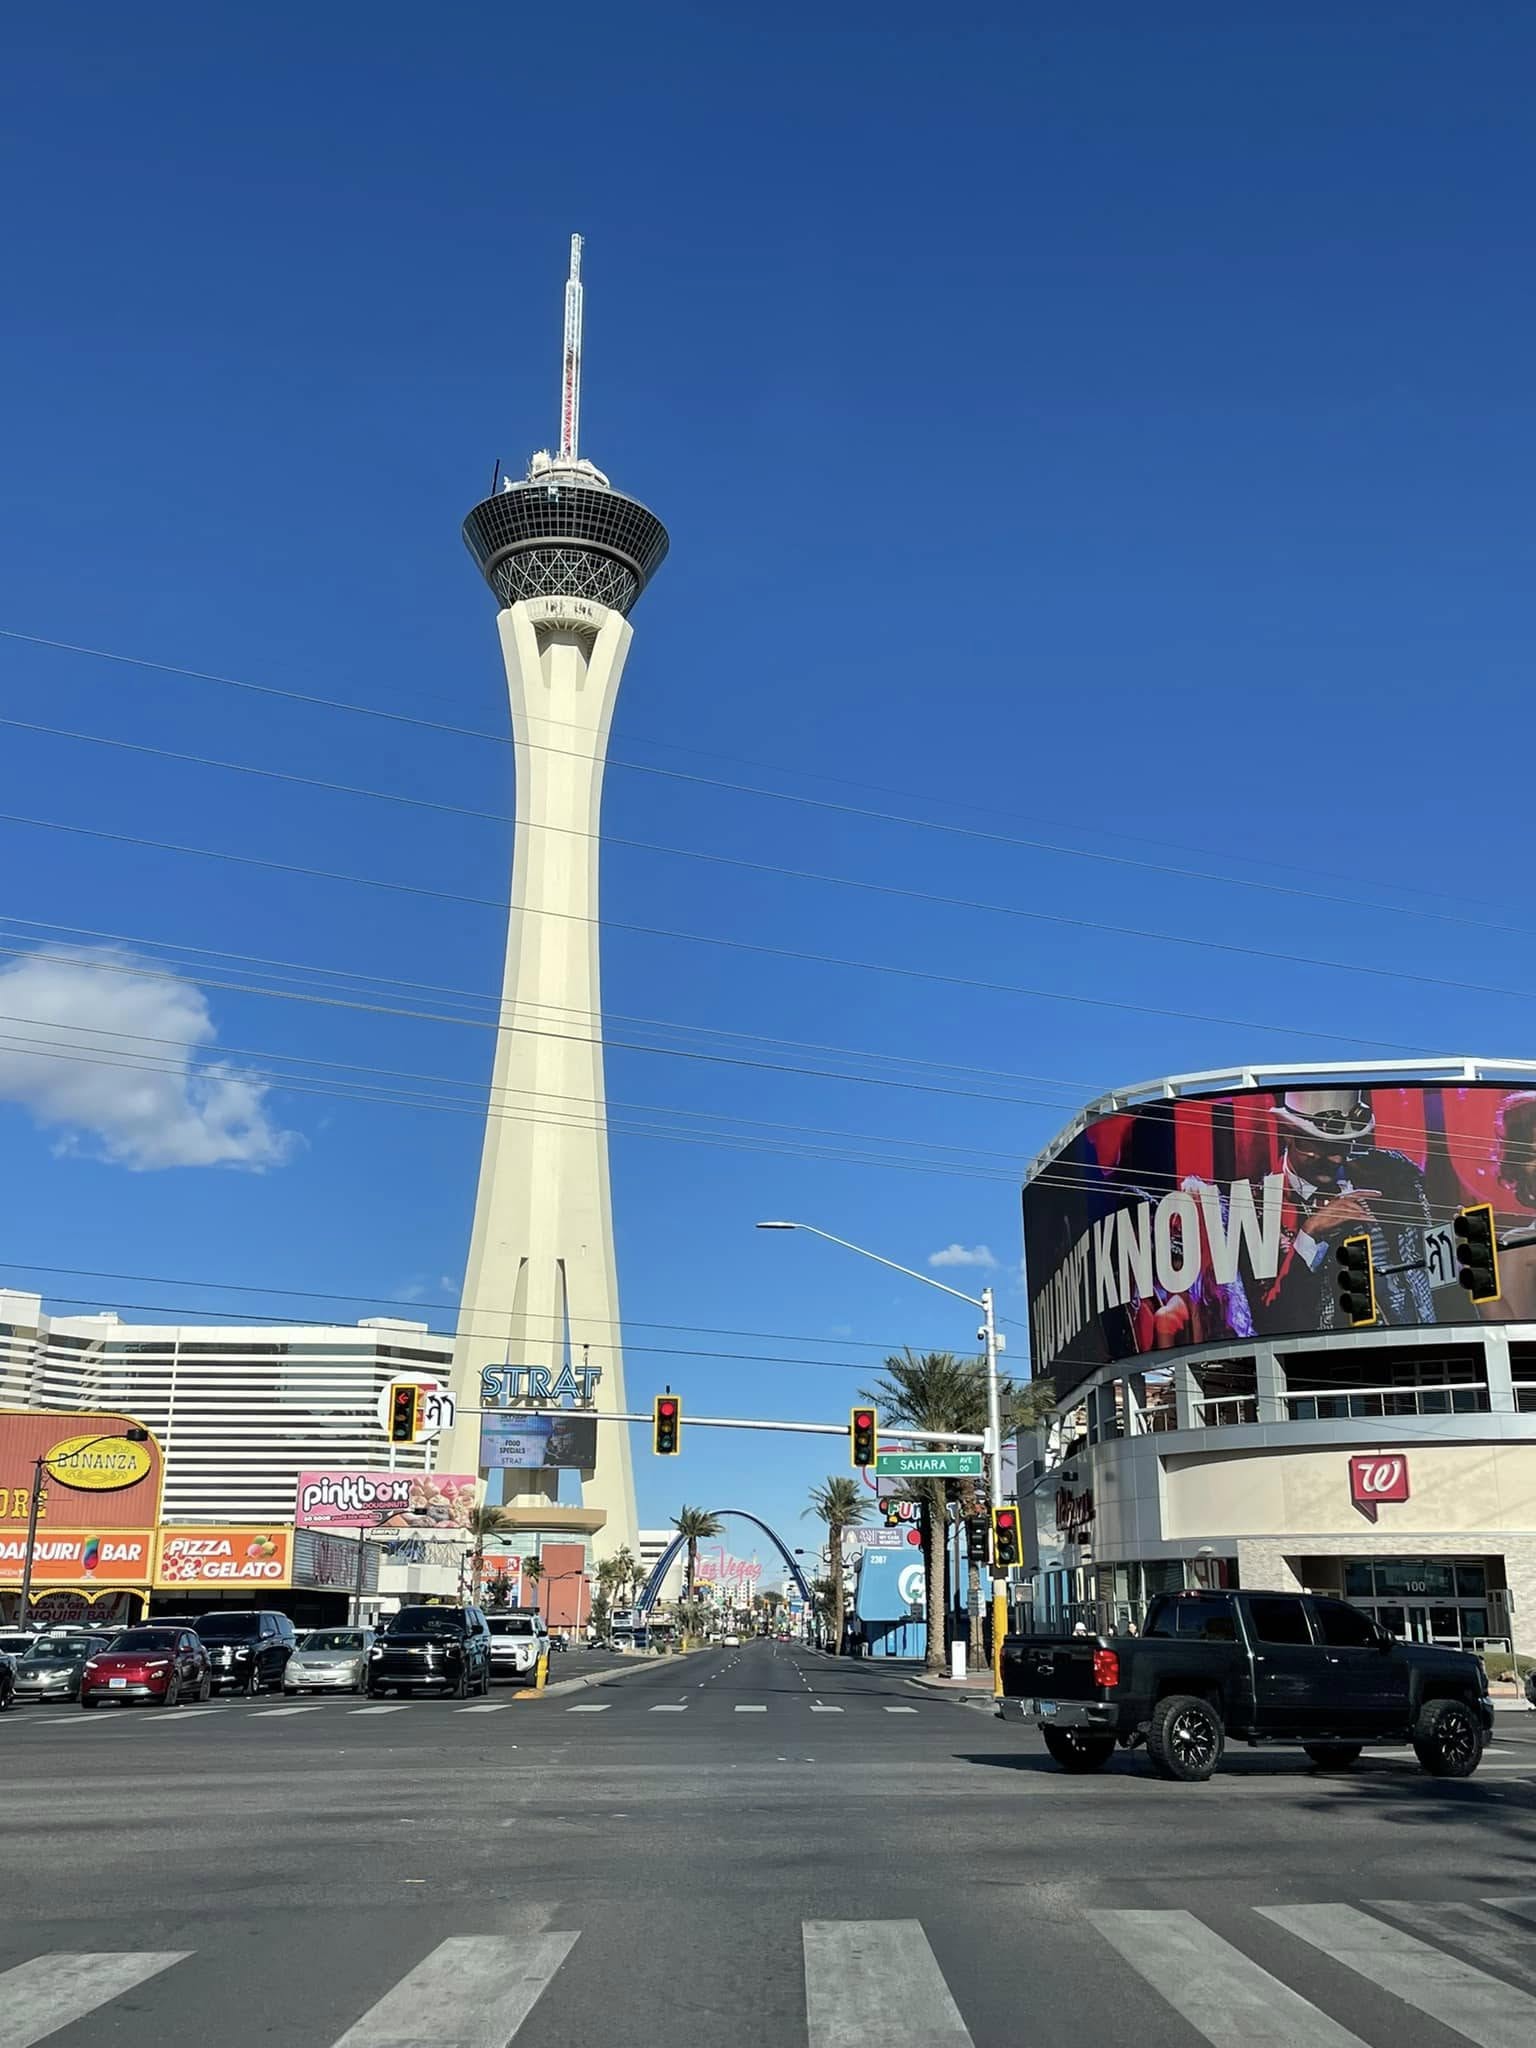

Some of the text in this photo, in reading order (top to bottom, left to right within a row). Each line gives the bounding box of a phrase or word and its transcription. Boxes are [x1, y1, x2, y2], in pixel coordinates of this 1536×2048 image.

[1033, 1173, 1285, 1373] YOU DON'T KNOW
[481, 1364, 602, 1399] STRAT
[58, 1452, 138, 1470] BONANZA
[900, 1460, 947, 1470] SAHARA
[303, 1475, 410, 1512] pinkbox
[361, 1501, 409, 1510] DOUGHNUTS
[101, 1543, 142, 1561] BAR
[169, 1539, 232, 1557] PIZZA
[180, 1561, 282, 1578] & GELATO
[711, 1545, 762, 1588] Vegas
[1406, 1581, 1426, 1592] 100
